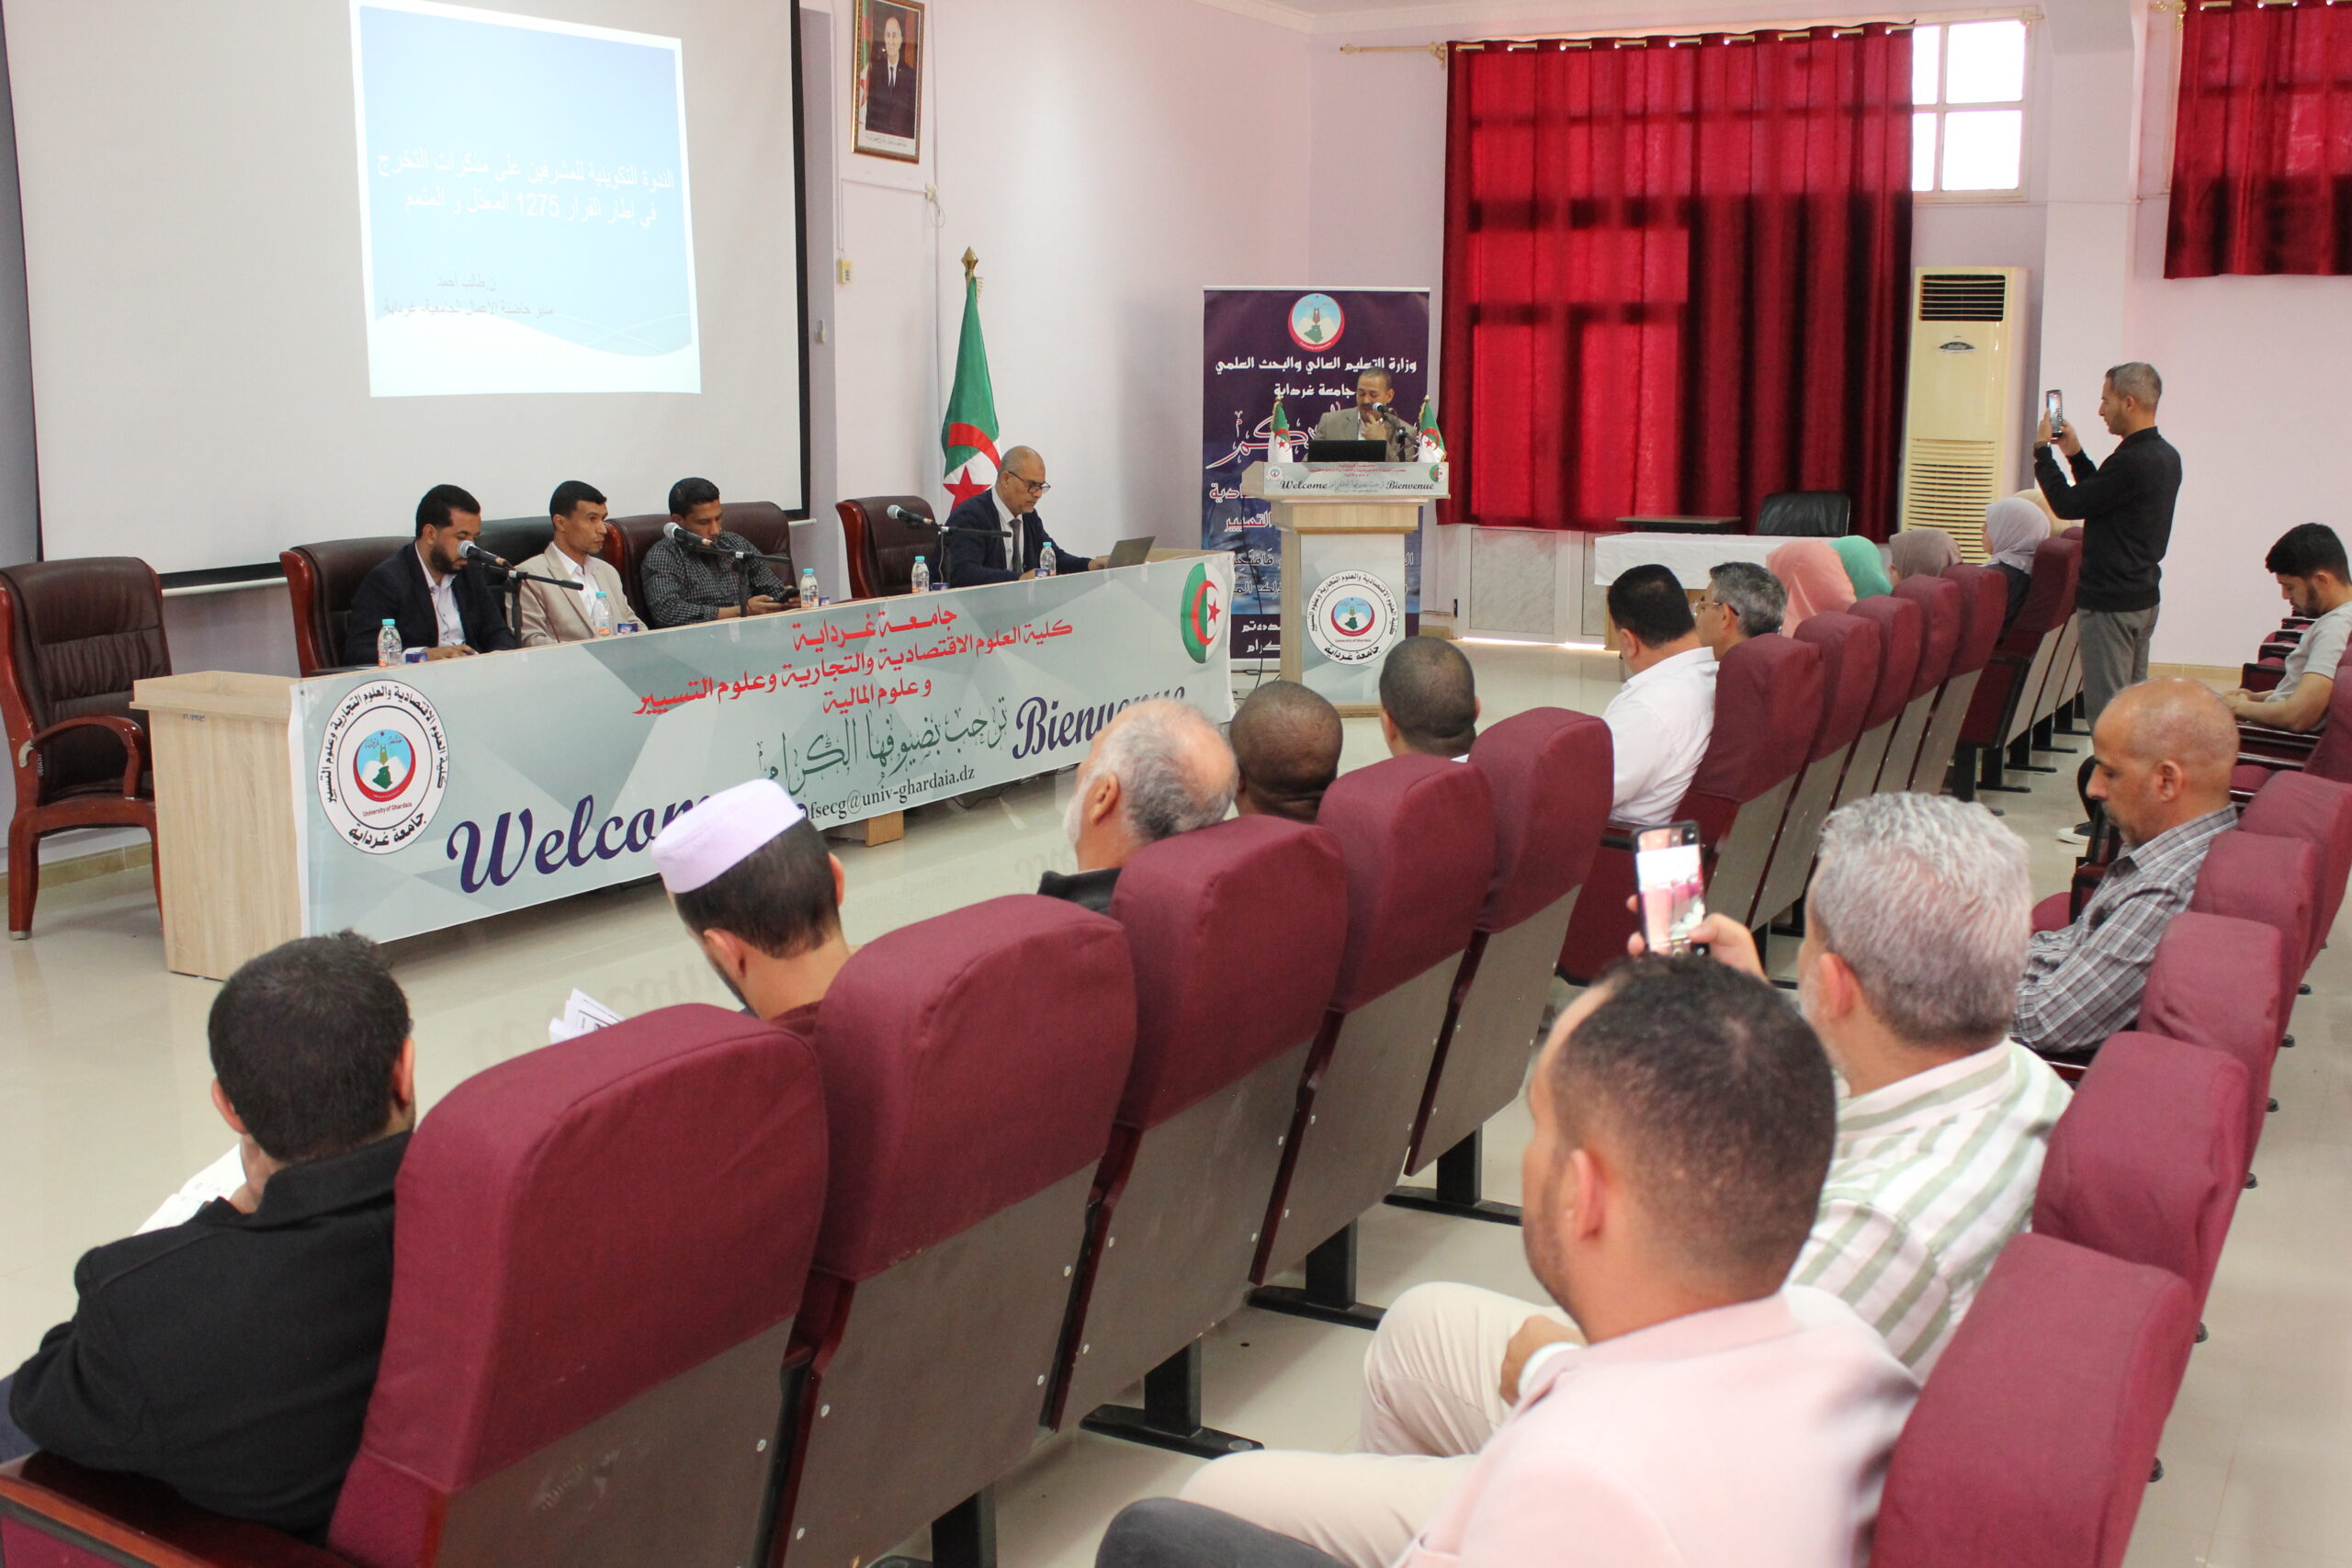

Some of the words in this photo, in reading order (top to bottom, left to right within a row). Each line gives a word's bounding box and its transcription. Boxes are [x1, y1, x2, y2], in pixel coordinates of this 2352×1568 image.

[377, 146, 427, 177] التخرج
[494, 152, 521, 182] على
[515, 191, 560, 218] 1275
[640, 200, 658, 229] في
[1215, 356, 1255, 375] العلمي
[1258, 356, 1302, 373] والبحث
[1305, 356, 1340, 375] العالي
[1344, 356, 1385, 371] التعليم
[1388, 357, 1418, 373] وزارة
[1273, 382, 1315, 400] غرداية
[1317, 383, 1356, 399] جامعة
[1279, 480, 1329, 491] Welcome
[1385, 480, 1434, 491] Bienvenue
[792, 613, 876, 652] غرداية
[876, 603, 958, 637] جامعة
[1023, 618, 1073, 645] كلية
[878, 634, 973, 671] الاقتصادية
[976, 626, 1021, 659] العلوم
[1324, 645, 1352, 661] غرداية
[1355, 646, 1381, 660] جامعة
[781, 651, 875, 689] والتجارية
[363, 684, 392, 705] والعلوم
[631, 675, 714, 716] التسيير
[718, 670, 777, 705] وعلوم
[823, 682, 874, 715] المالية
[330, 694, 362, 731] التجارية
[393, 685, 436, 725] الاقتصادية
[324, 731, 338, 764] وعلوم
[431, 724, 447, 754] العلوم
[320, 766, 338, 804] التسيير
[435, 754, 449, 789] كلية
[810, 764, 976, 821] fsecg@univ-ghardaia.dz
[348, 823, 390, 849] غرداية
[393, 811, 427, 843] جامعة
